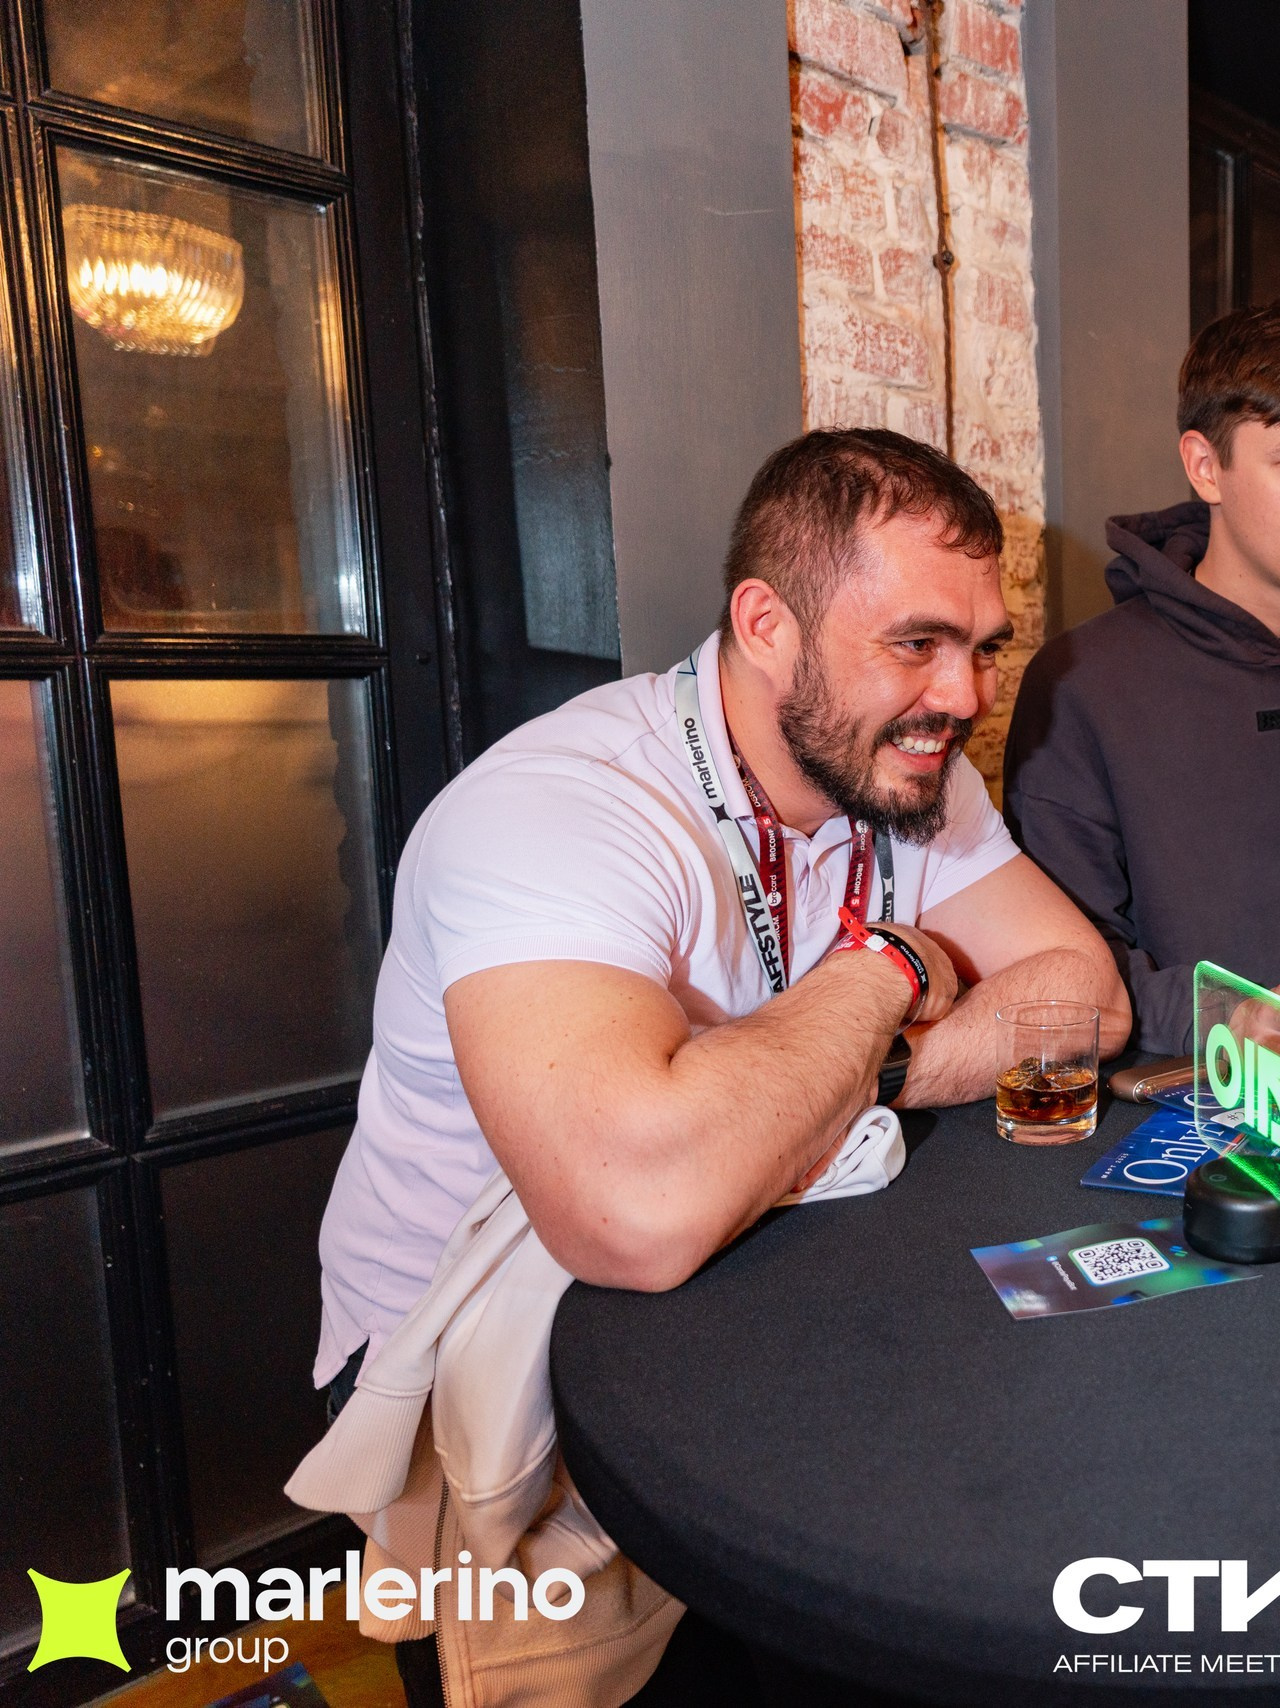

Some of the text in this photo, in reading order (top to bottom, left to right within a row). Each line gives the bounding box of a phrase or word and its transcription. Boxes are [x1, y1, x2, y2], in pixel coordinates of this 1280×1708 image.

[684, 717, 718, 799] marlerino
[768, 829, 776, 862] BROCONF
[853, 863, 864, 895] BROCONF
[739, 873, 784, 993] AFFSTYLE
